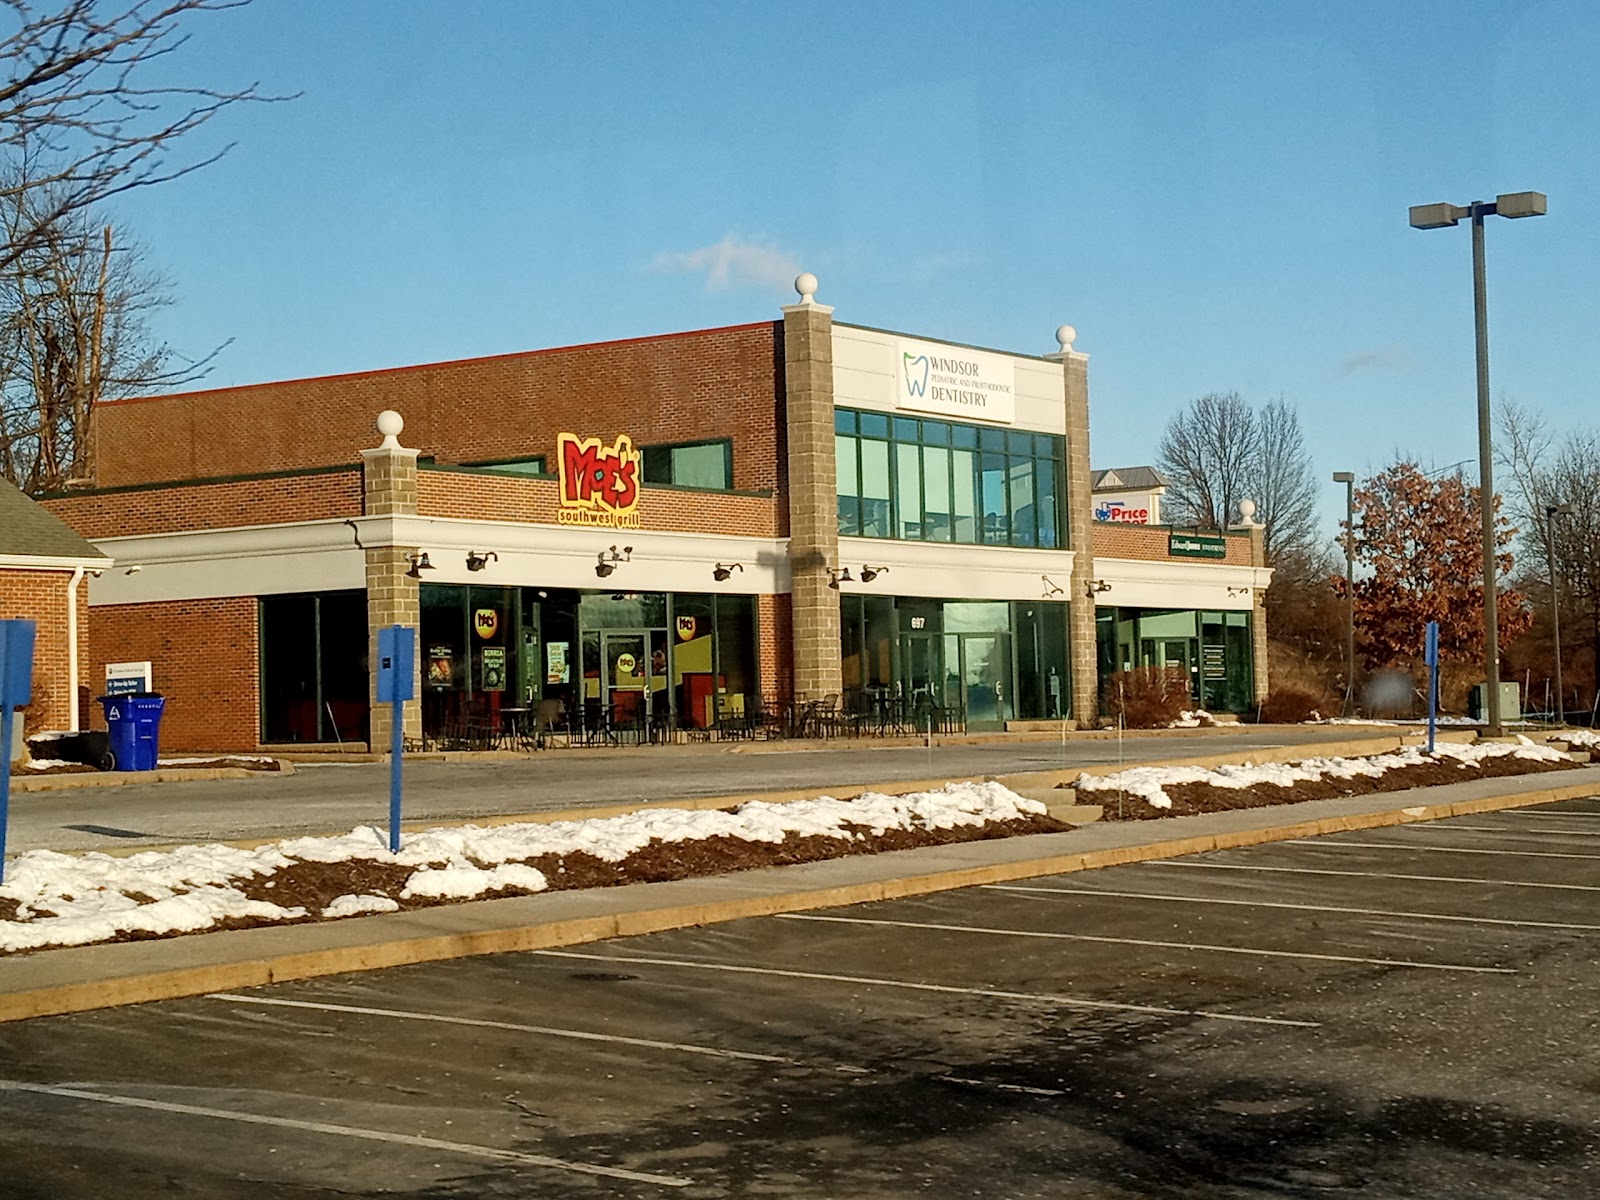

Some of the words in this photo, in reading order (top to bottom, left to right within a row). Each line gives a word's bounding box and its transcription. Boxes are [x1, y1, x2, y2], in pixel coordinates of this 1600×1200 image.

[930, 356, 979, 377] WINDSOR
[931, 374, 958, 386] PEDIATRIC
[959, 378, 971, 387] AND
[931, 386, 988, 407] DENTISTRY
[559, 509, 614, 525] southwest
[617, 513, 639, 527] grill
[1111, 508, 1148, 520] Price
